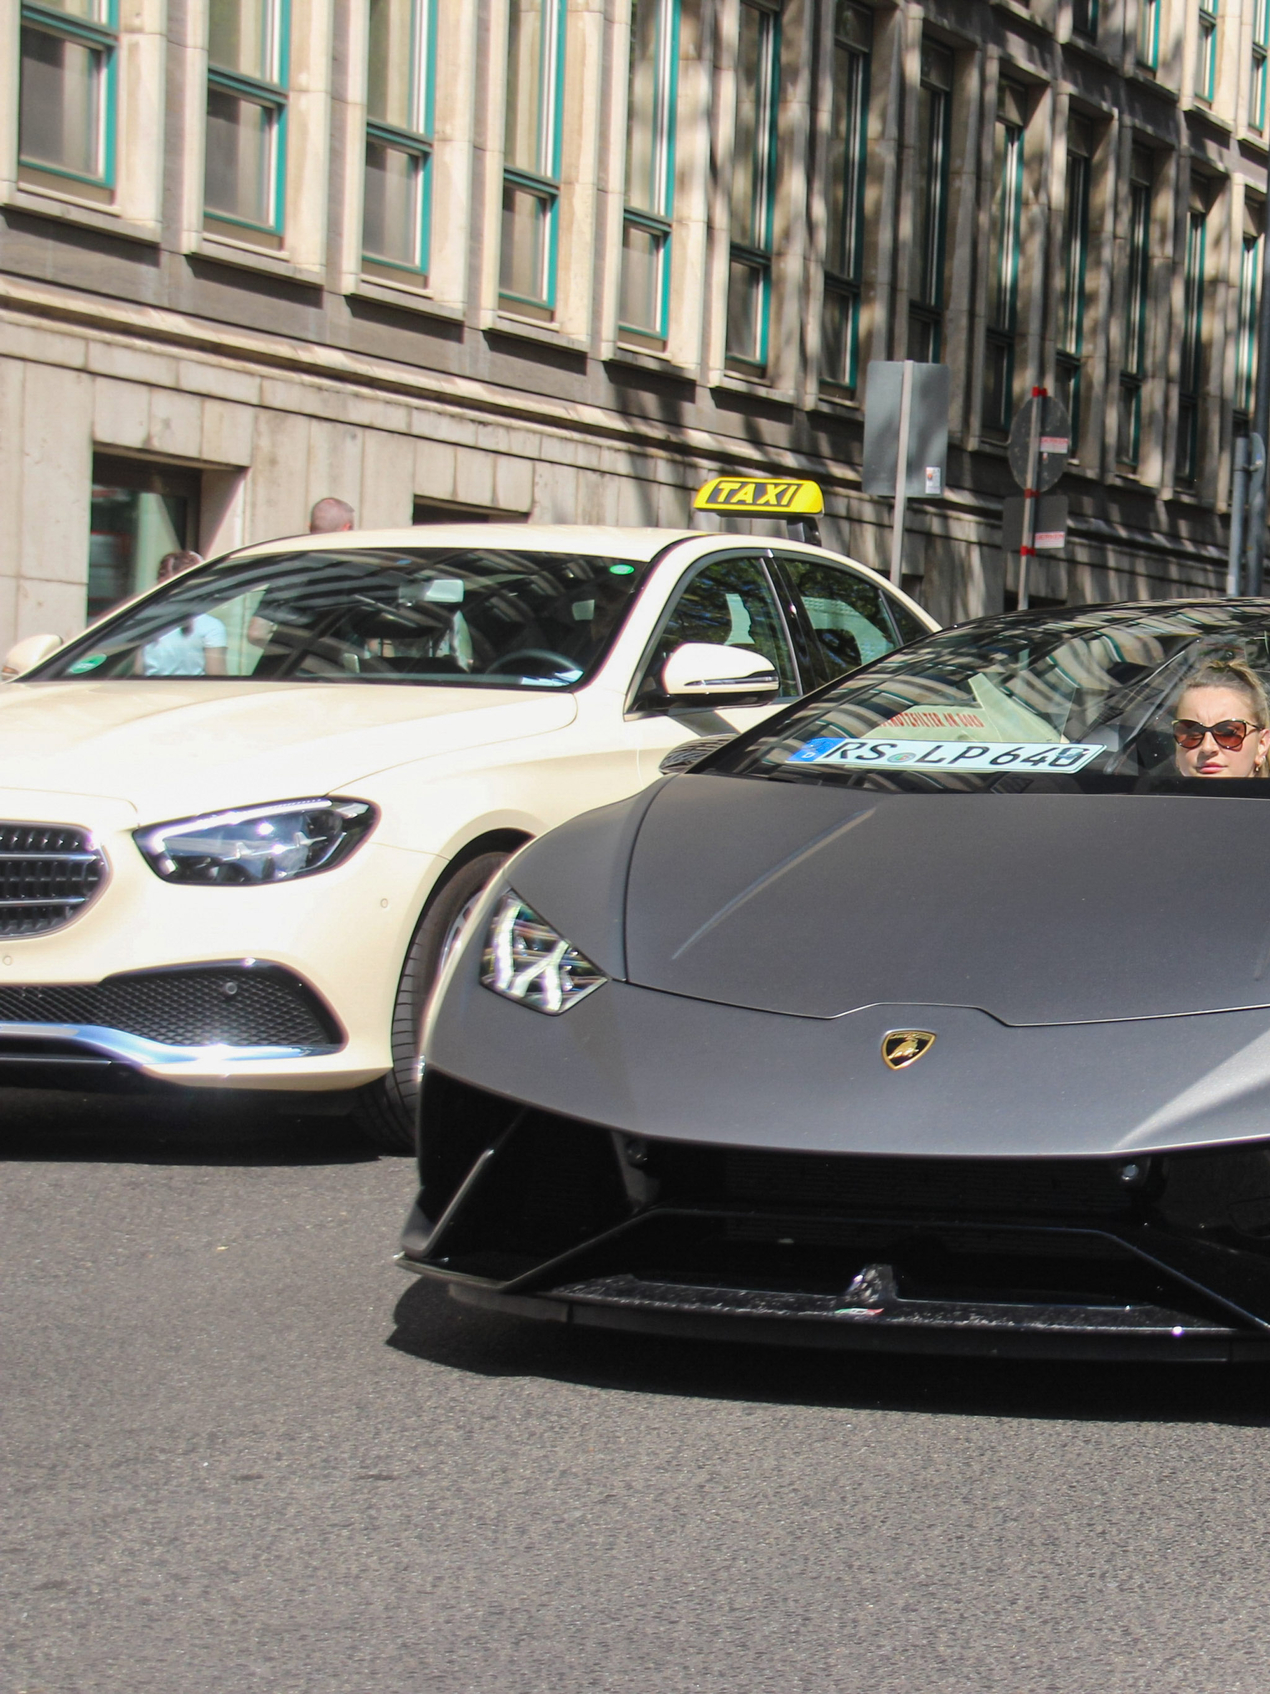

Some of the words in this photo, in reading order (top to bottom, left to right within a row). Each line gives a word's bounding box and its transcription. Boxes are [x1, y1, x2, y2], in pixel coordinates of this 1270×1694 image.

[717, 482, 799, 506] TAXI
[823, 742, 898, 762] RS
[914, 745, 990, 763] LP
